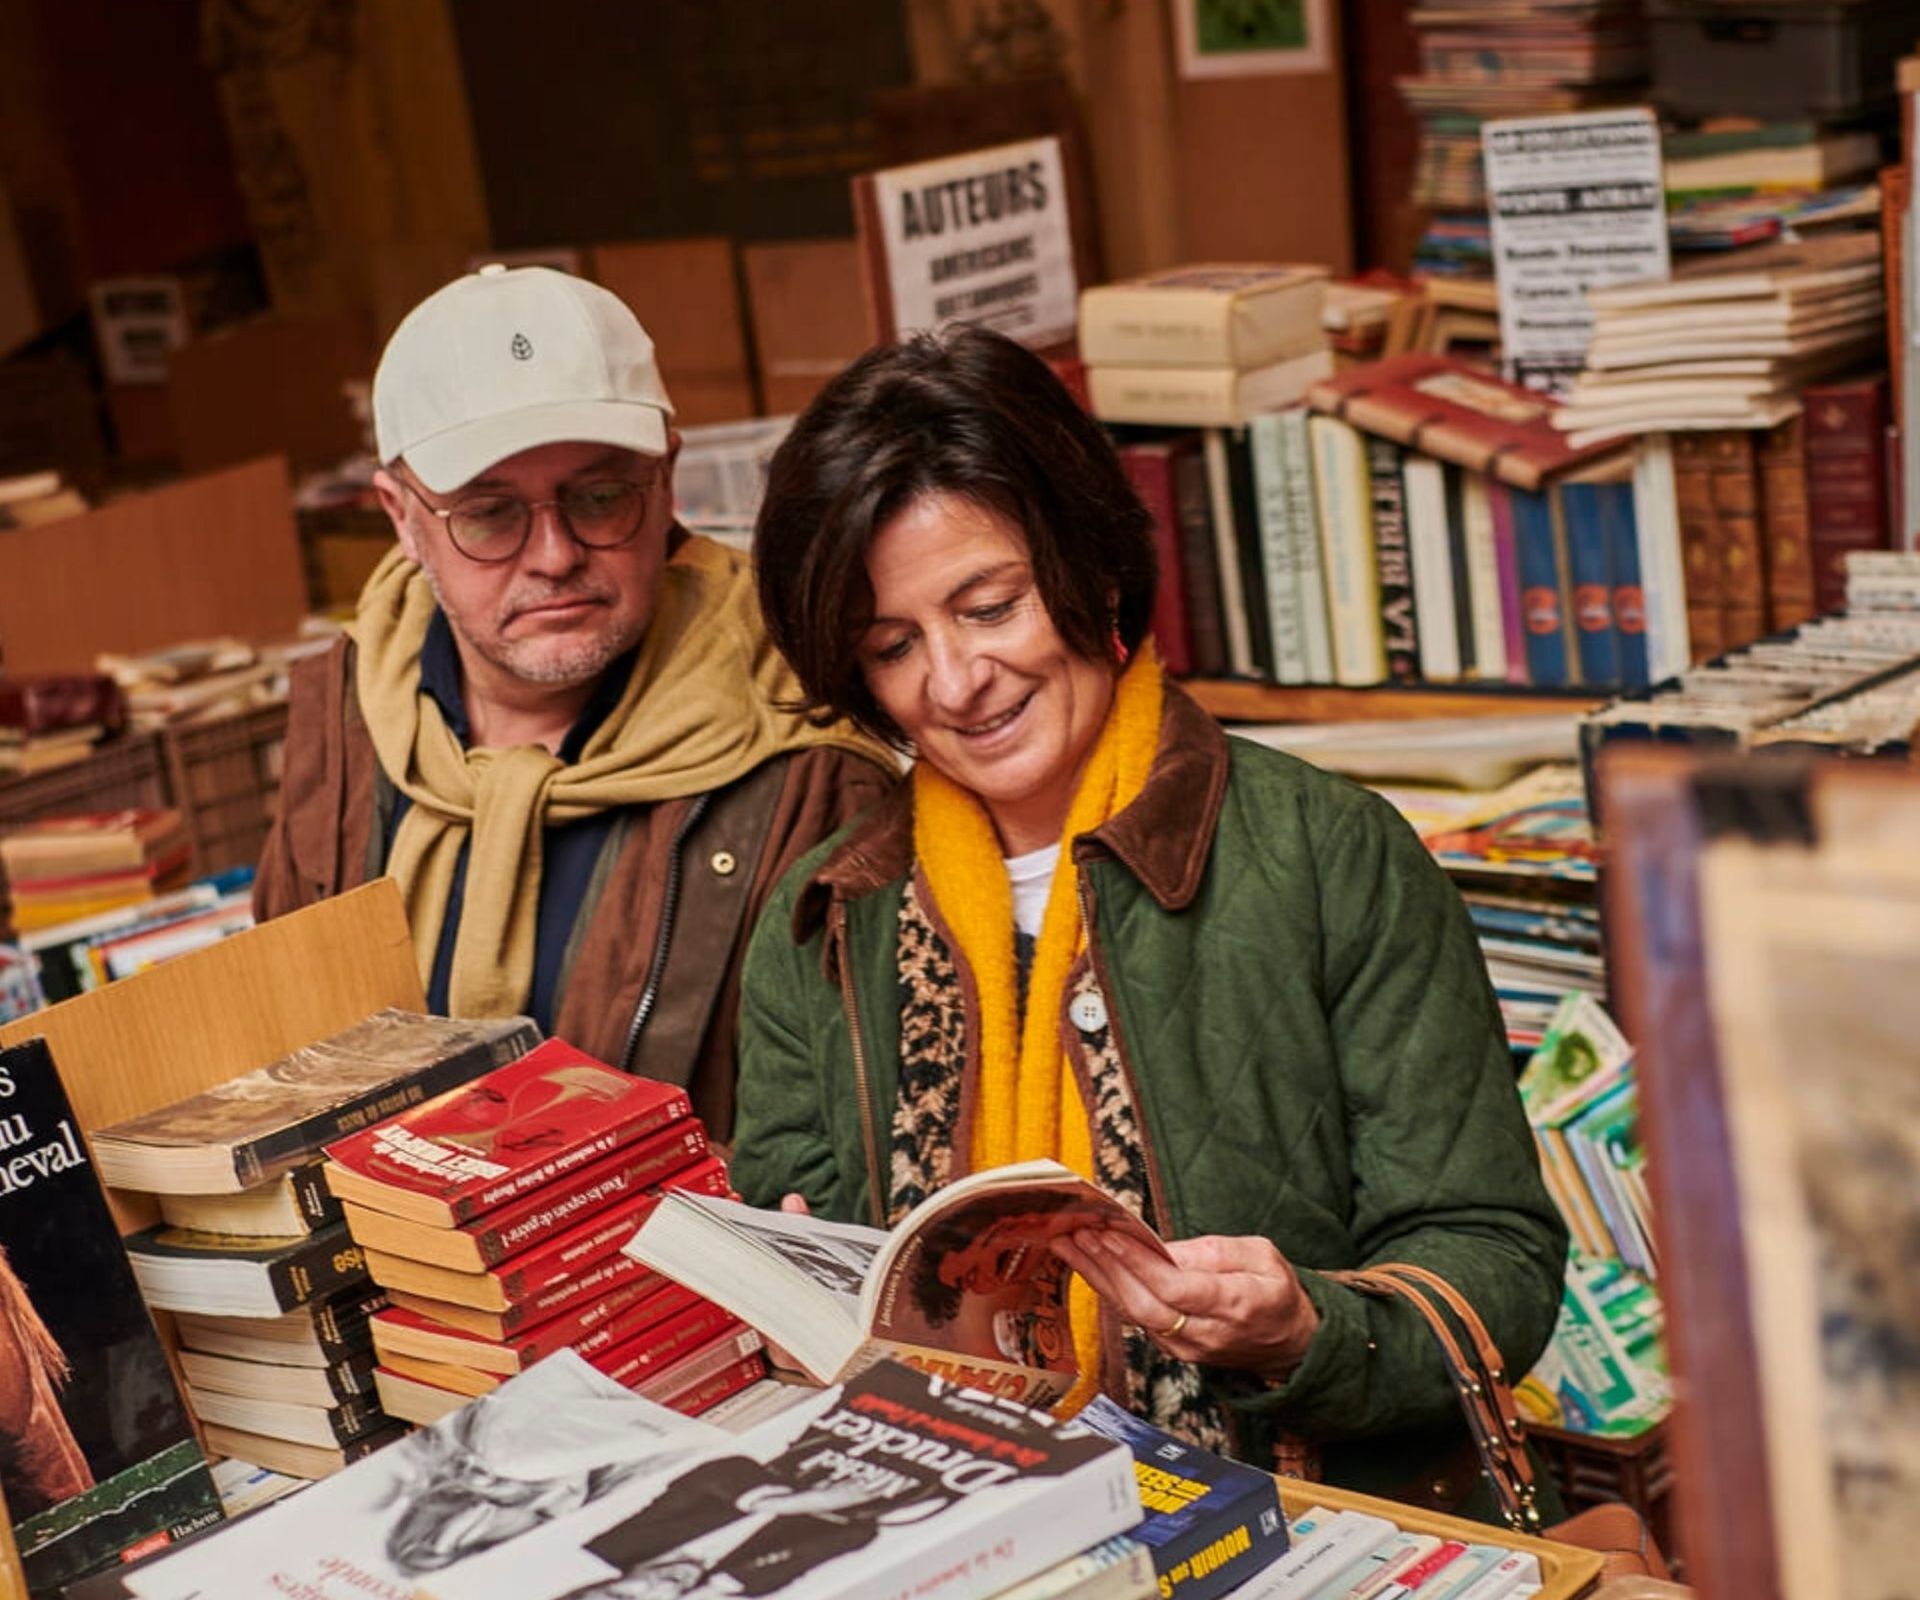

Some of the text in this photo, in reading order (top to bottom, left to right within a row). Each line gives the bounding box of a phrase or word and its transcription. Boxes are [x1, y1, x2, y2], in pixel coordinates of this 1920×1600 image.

[902, 160, 1048, 242] AUTEURS
[1371, 473, 1417, 652] LA BIBLE
[0, 1112, 34, 1150] u
[879, 1273, 902, 1328] Jacques
[811, 1408, 1020, 1495] Drucker
[1189, 1524, 1252, 1580] MOURIR
